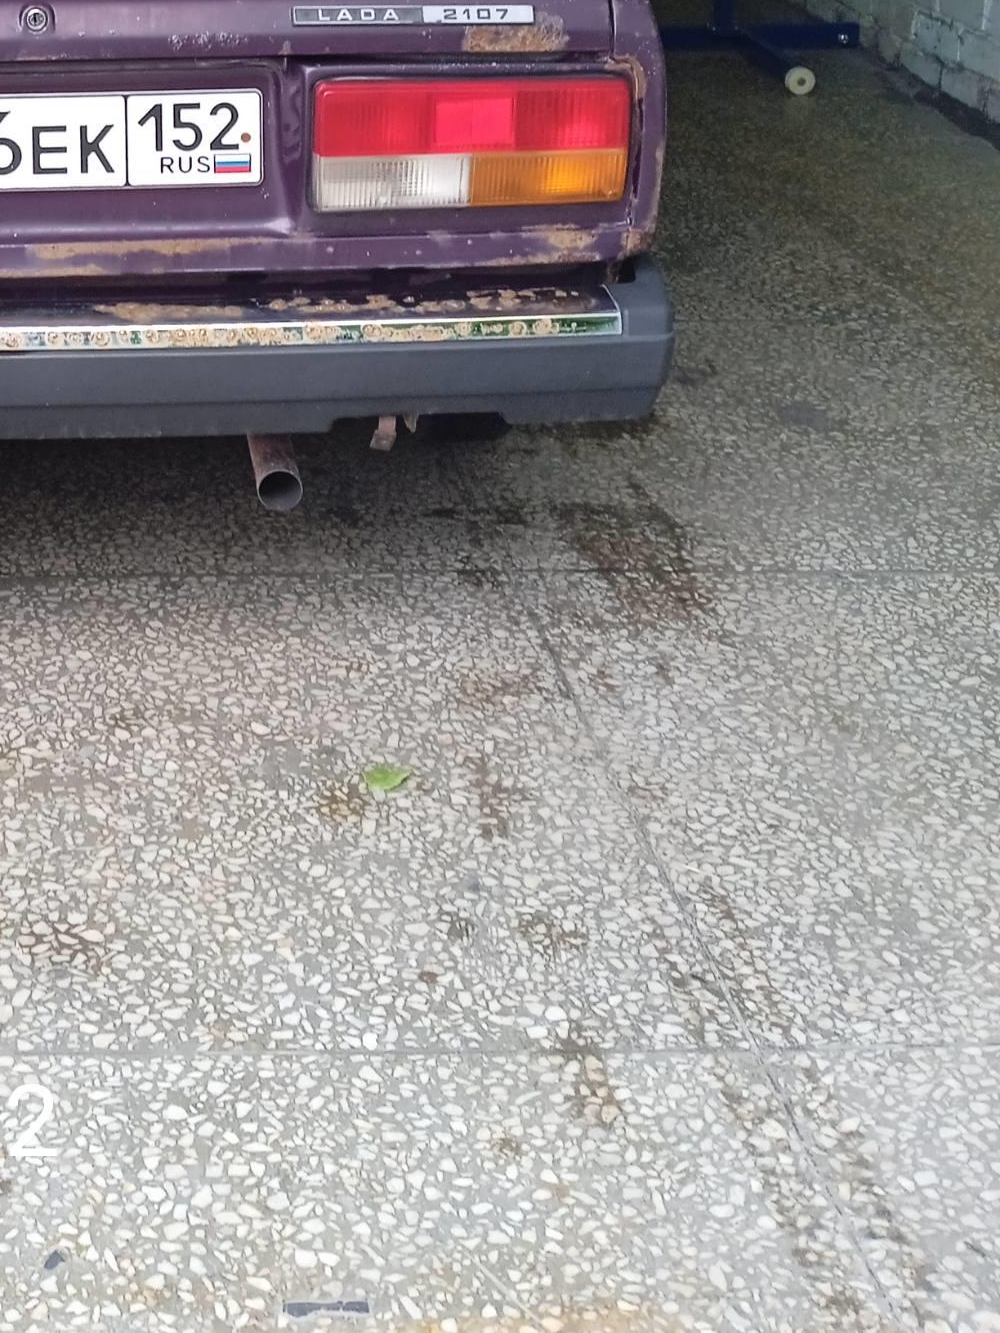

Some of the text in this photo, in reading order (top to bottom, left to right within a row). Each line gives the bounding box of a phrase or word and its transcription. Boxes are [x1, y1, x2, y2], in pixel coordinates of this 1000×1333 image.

[318, 8, 509, 21] LADA 2107
[138, 102, 240, 151] 152
[160, 155, 210, 174] RUS
